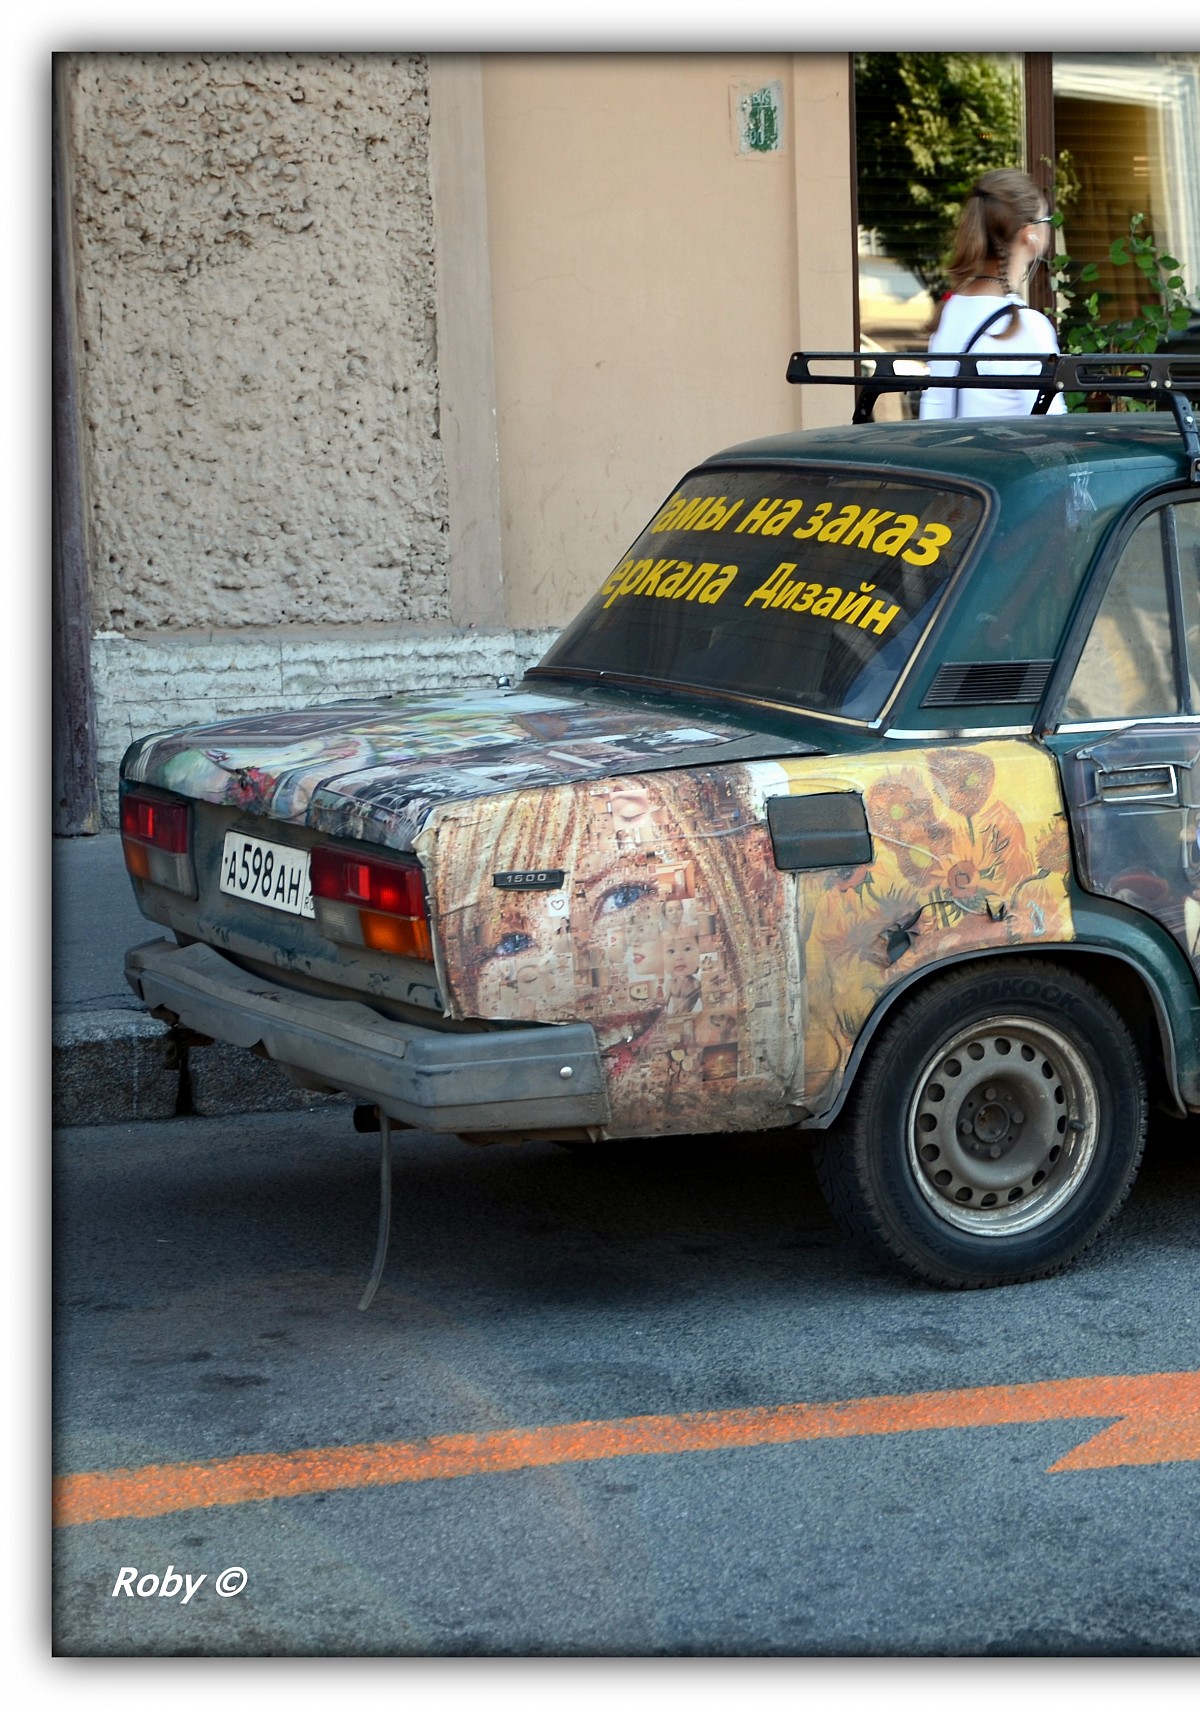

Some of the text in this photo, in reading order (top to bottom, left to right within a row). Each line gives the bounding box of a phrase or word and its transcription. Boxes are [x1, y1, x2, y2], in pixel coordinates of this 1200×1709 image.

[735, 499, 803, 536] на
[793, 501, 953, 567] заказ
[601, 555, 901, 635] еркала Дизайн
[226, 843, 302, 907] А598АН
[506, 873, 547, 883] 1500
